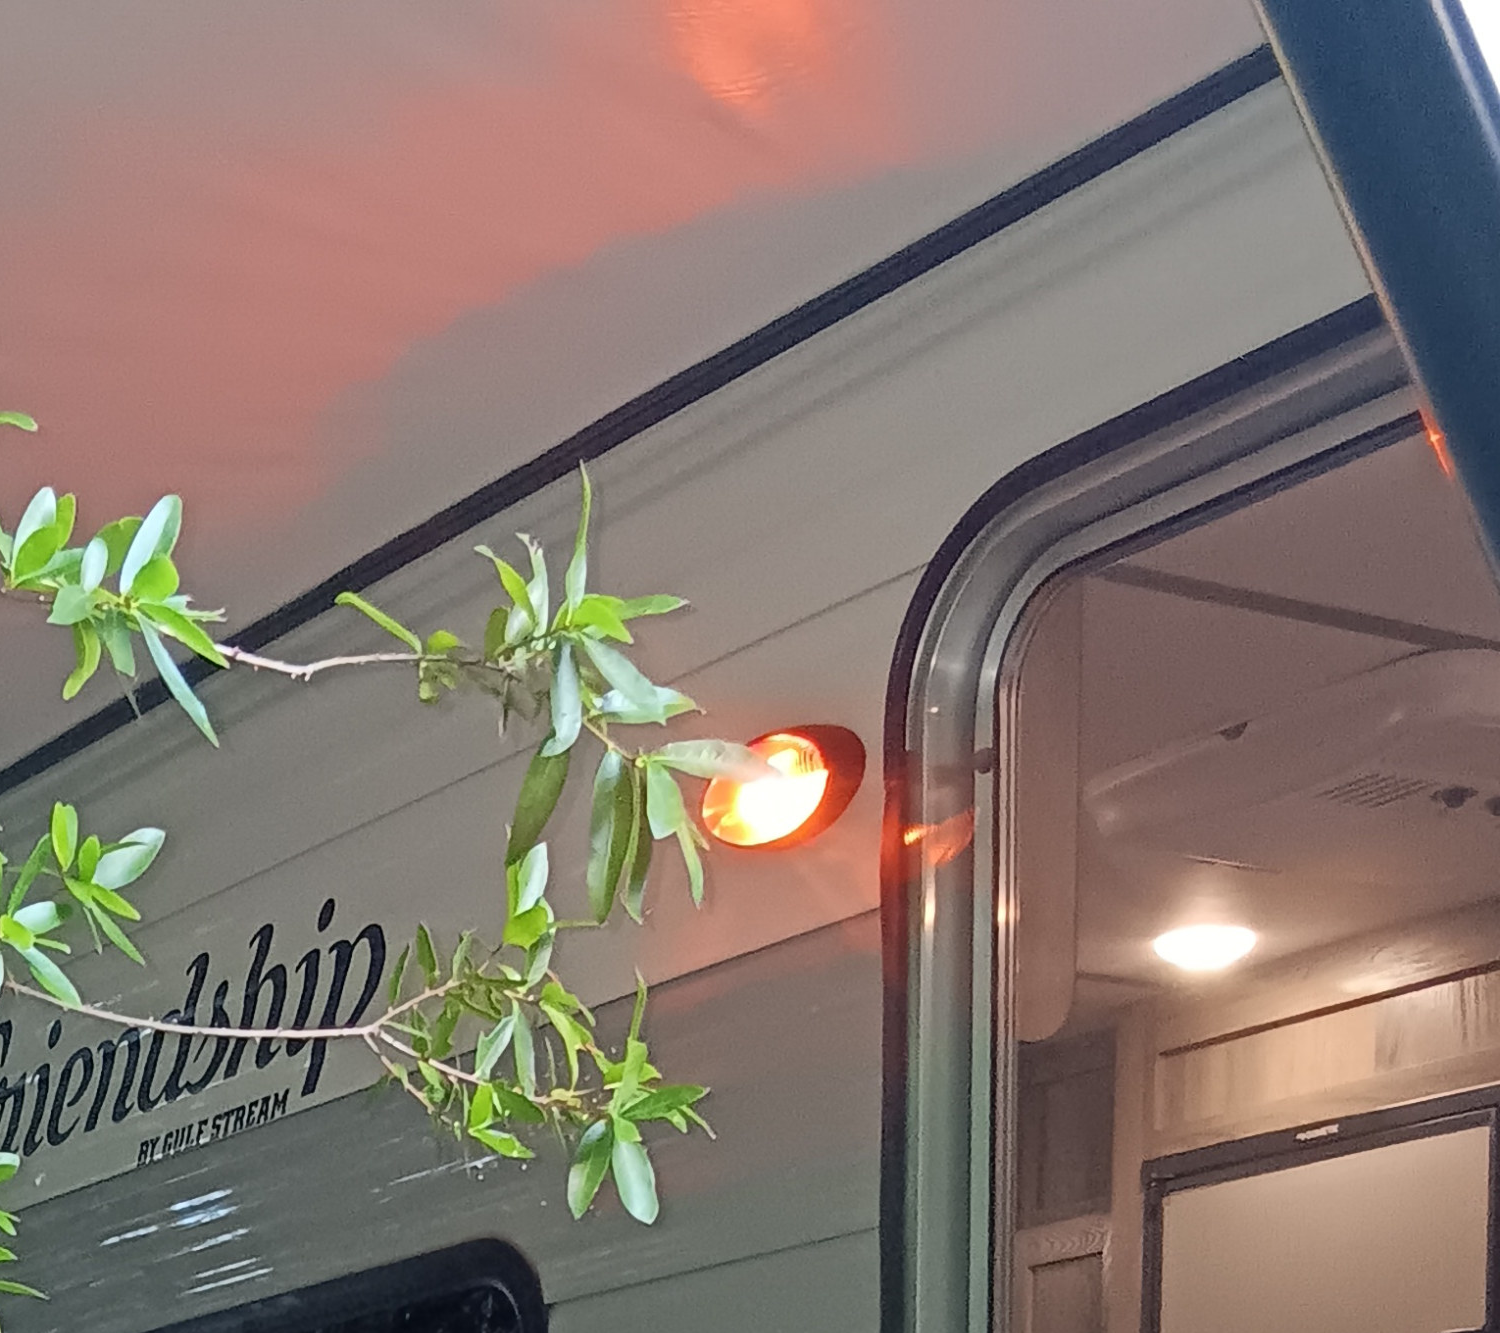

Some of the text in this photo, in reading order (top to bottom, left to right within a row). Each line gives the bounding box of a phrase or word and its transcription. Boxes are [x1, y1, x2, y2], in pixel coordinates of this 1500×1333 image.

[137, 1088, 291, 1168] BY GULF STREAM
